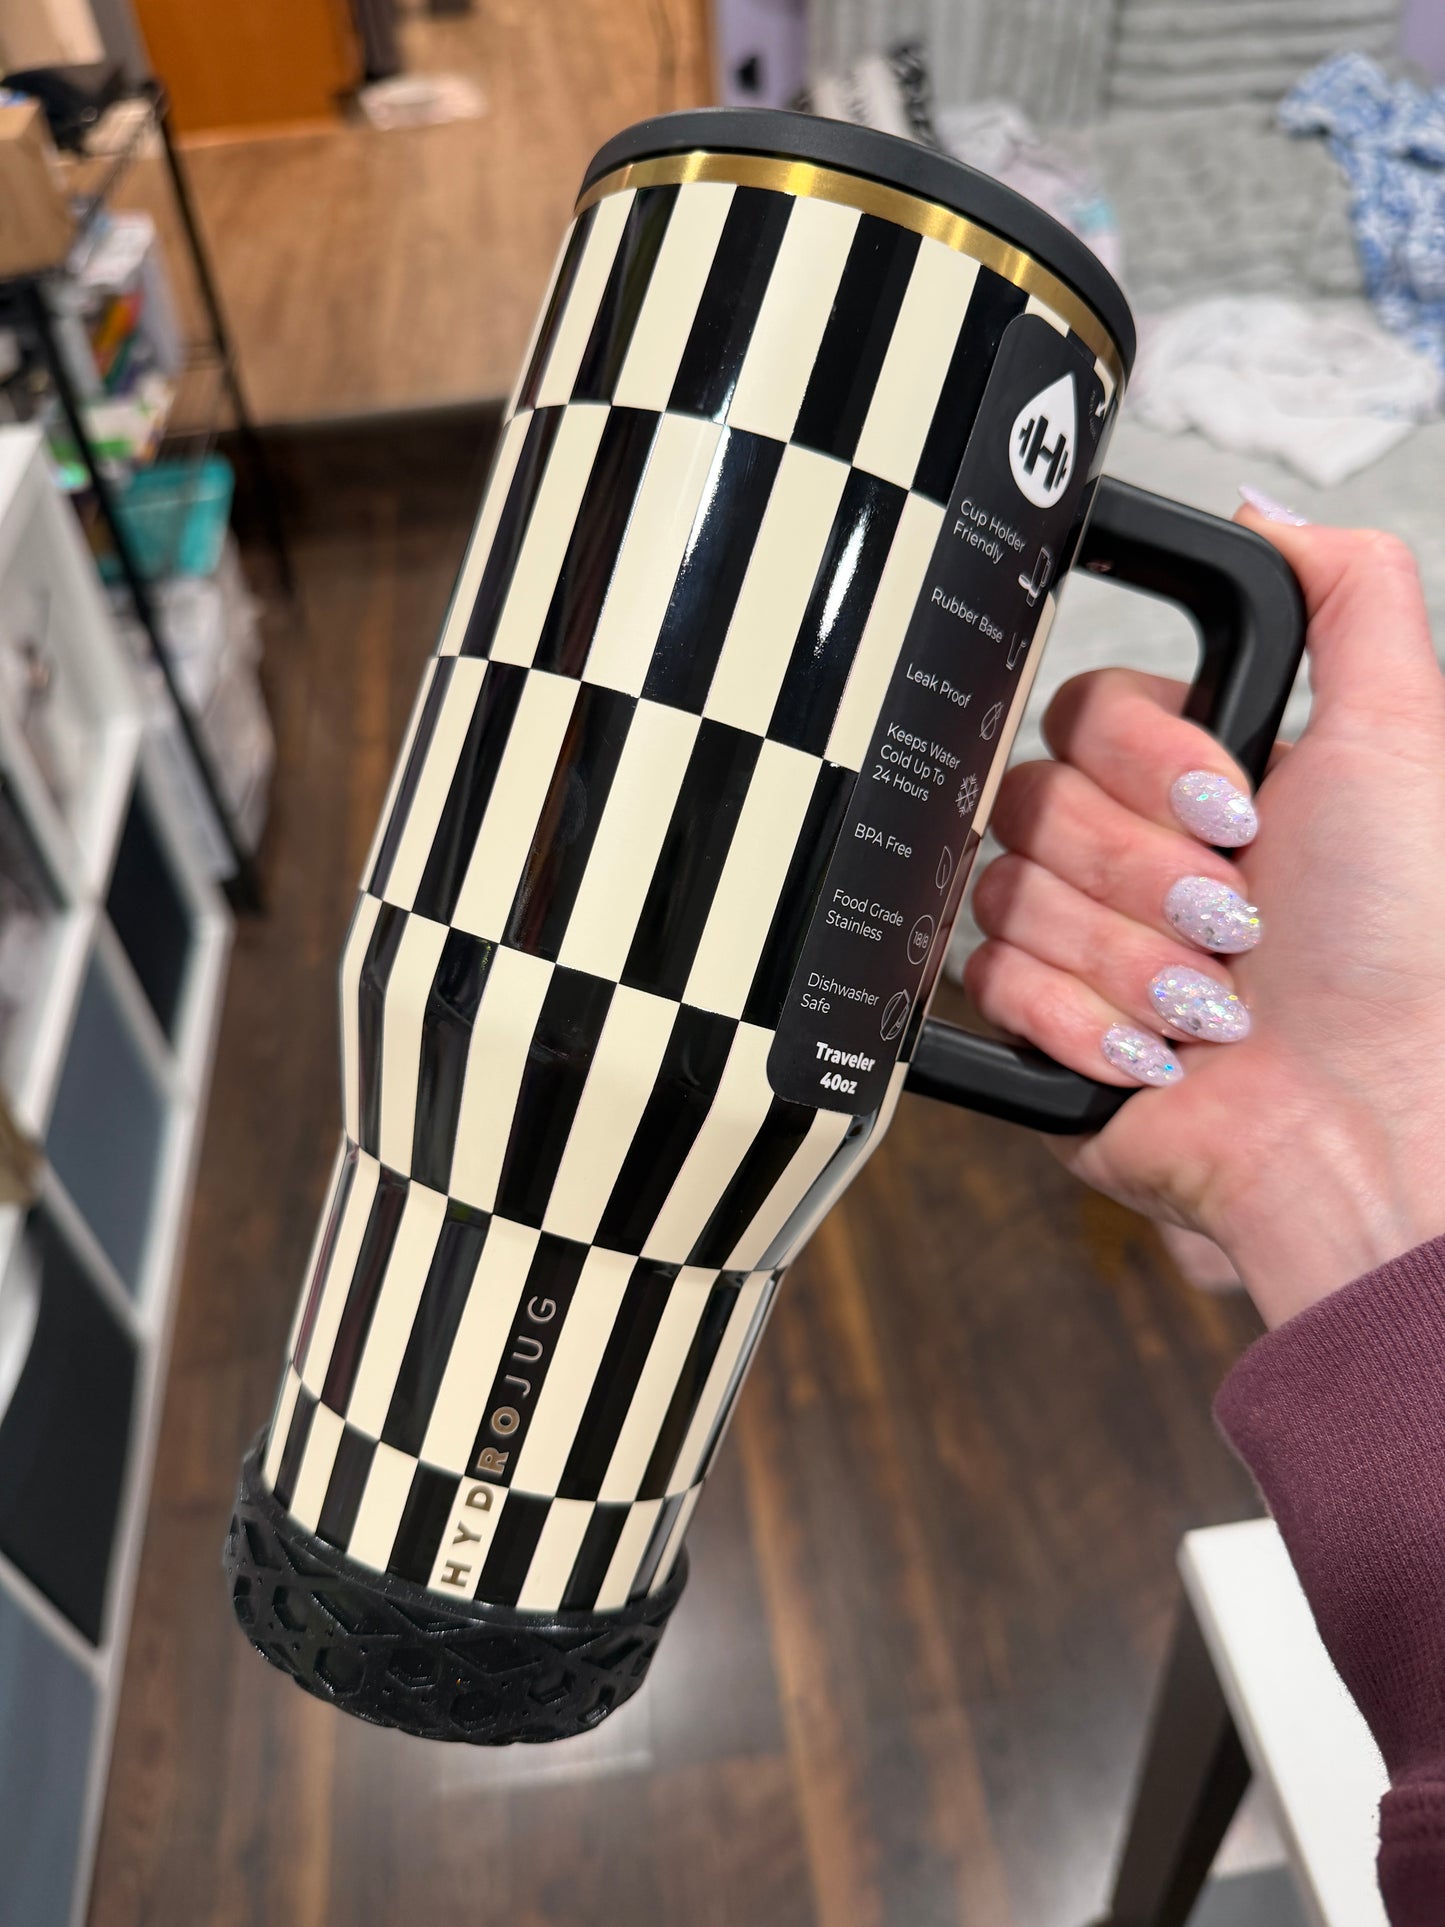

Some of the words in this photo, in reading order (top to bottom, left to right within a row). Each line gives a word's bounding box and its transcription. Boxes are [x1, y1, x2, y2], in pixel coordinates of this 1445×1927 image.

[953, 520, 1005, 565] Friendly
[960, 499, 988, 528] Cup
[988, 510, 1026, 553] Holder
[931, 587, 978, 626] Rubber
[978, 617, 1004, 644] Base
[906, 663, 937, 692] Leak
[939, 684, 973, 708] Proof
[880, 744, 911, 770] Cold
[913, 758, 931, 781] Up
[930, 767, 945, 786] To
[887, 722, 928, 754] Keeps
[929, 741, 961, 770] Water
[872, 764, 891, 784] 24
[893, 775, 930, 802] Hours
[854, 823, 883, 847] BPA
[885, 835, 913, 858] Free
[825, 910, 883, 942] Stainless
[832, 888, 869, 913] Food
[869, 903, 904, 927] Grade
[912, 930, 929, 949] 18/8
[800, 993, 831, 1014] Safe
[807, 972, 880, 1007] Dishwasher
[815, 1041, 876, 1072] Traveler
[819, 1072, 858, 1095] 40oz
[441, 1295, 557, 1588] HYDROJUG
